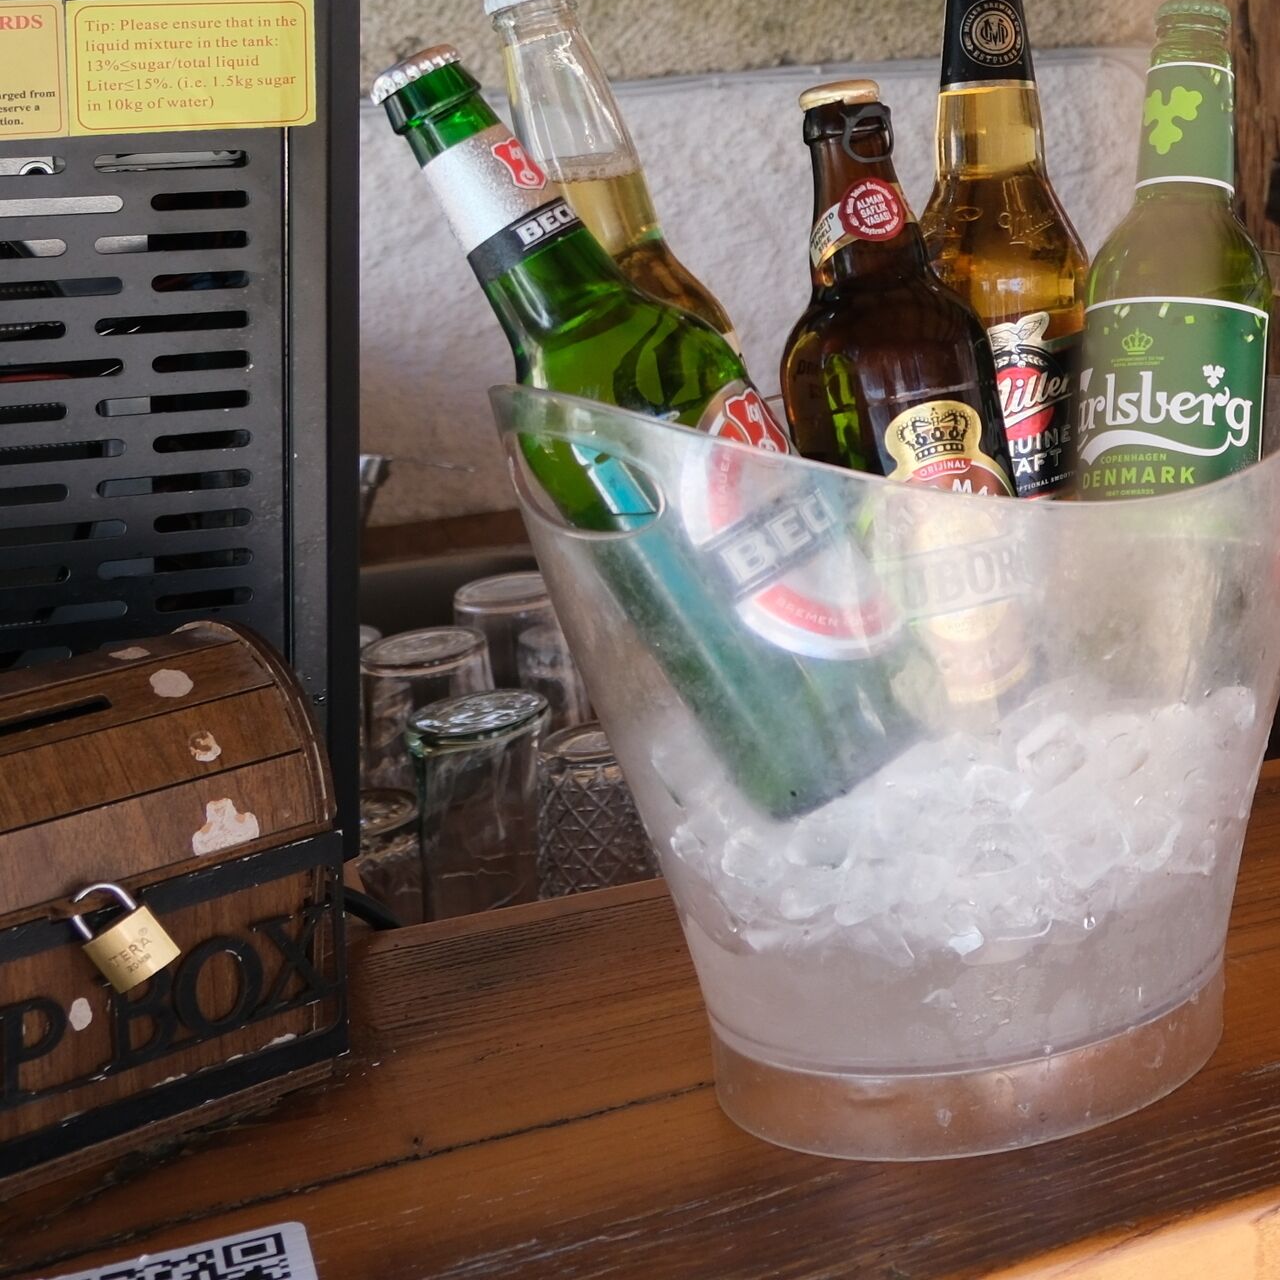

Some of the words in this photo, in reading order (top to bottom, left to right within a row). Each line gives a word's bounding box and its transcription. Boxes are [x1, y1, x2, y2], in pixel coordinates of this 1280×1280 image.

[85, 19, 115, 34] Tip:
[120, 19, 168, 31] Please
[172, 18, 222, 29] ensure
[226, 16, 254, 29] that
[257, 16, 272, 28] in
[275, 15, 298, 27] the
[85, 39, 129, 55] liquid
[134, 38, 193, 51] mixture
[197, 37, 212, 49] in
[215, 37, 239, 48] the
[241, 35, 279, 48] tank:
[215, 54, 260, 70] liquid
[212, 75, 253, 90] 1.5kg
[257, 75, 297, 88] sugar
[30, 89, 56, 99] from
[87, 101, 101, 112] in
[106, 98, 143, 113] 10kg
[147, 97, 165, 109] of
[166, 96, 214, 109] water)
[856, 193, 885, 210] ALMAN
[860, 202, 888, 218] SAFLIK
[864, 210, 892, 227] YASASI
[1015, 450, 1063, 478] AFT
[1101, 453, 1167, 465] COPENHAGEN
[1082, 466, 1195, 490] DENMARK
